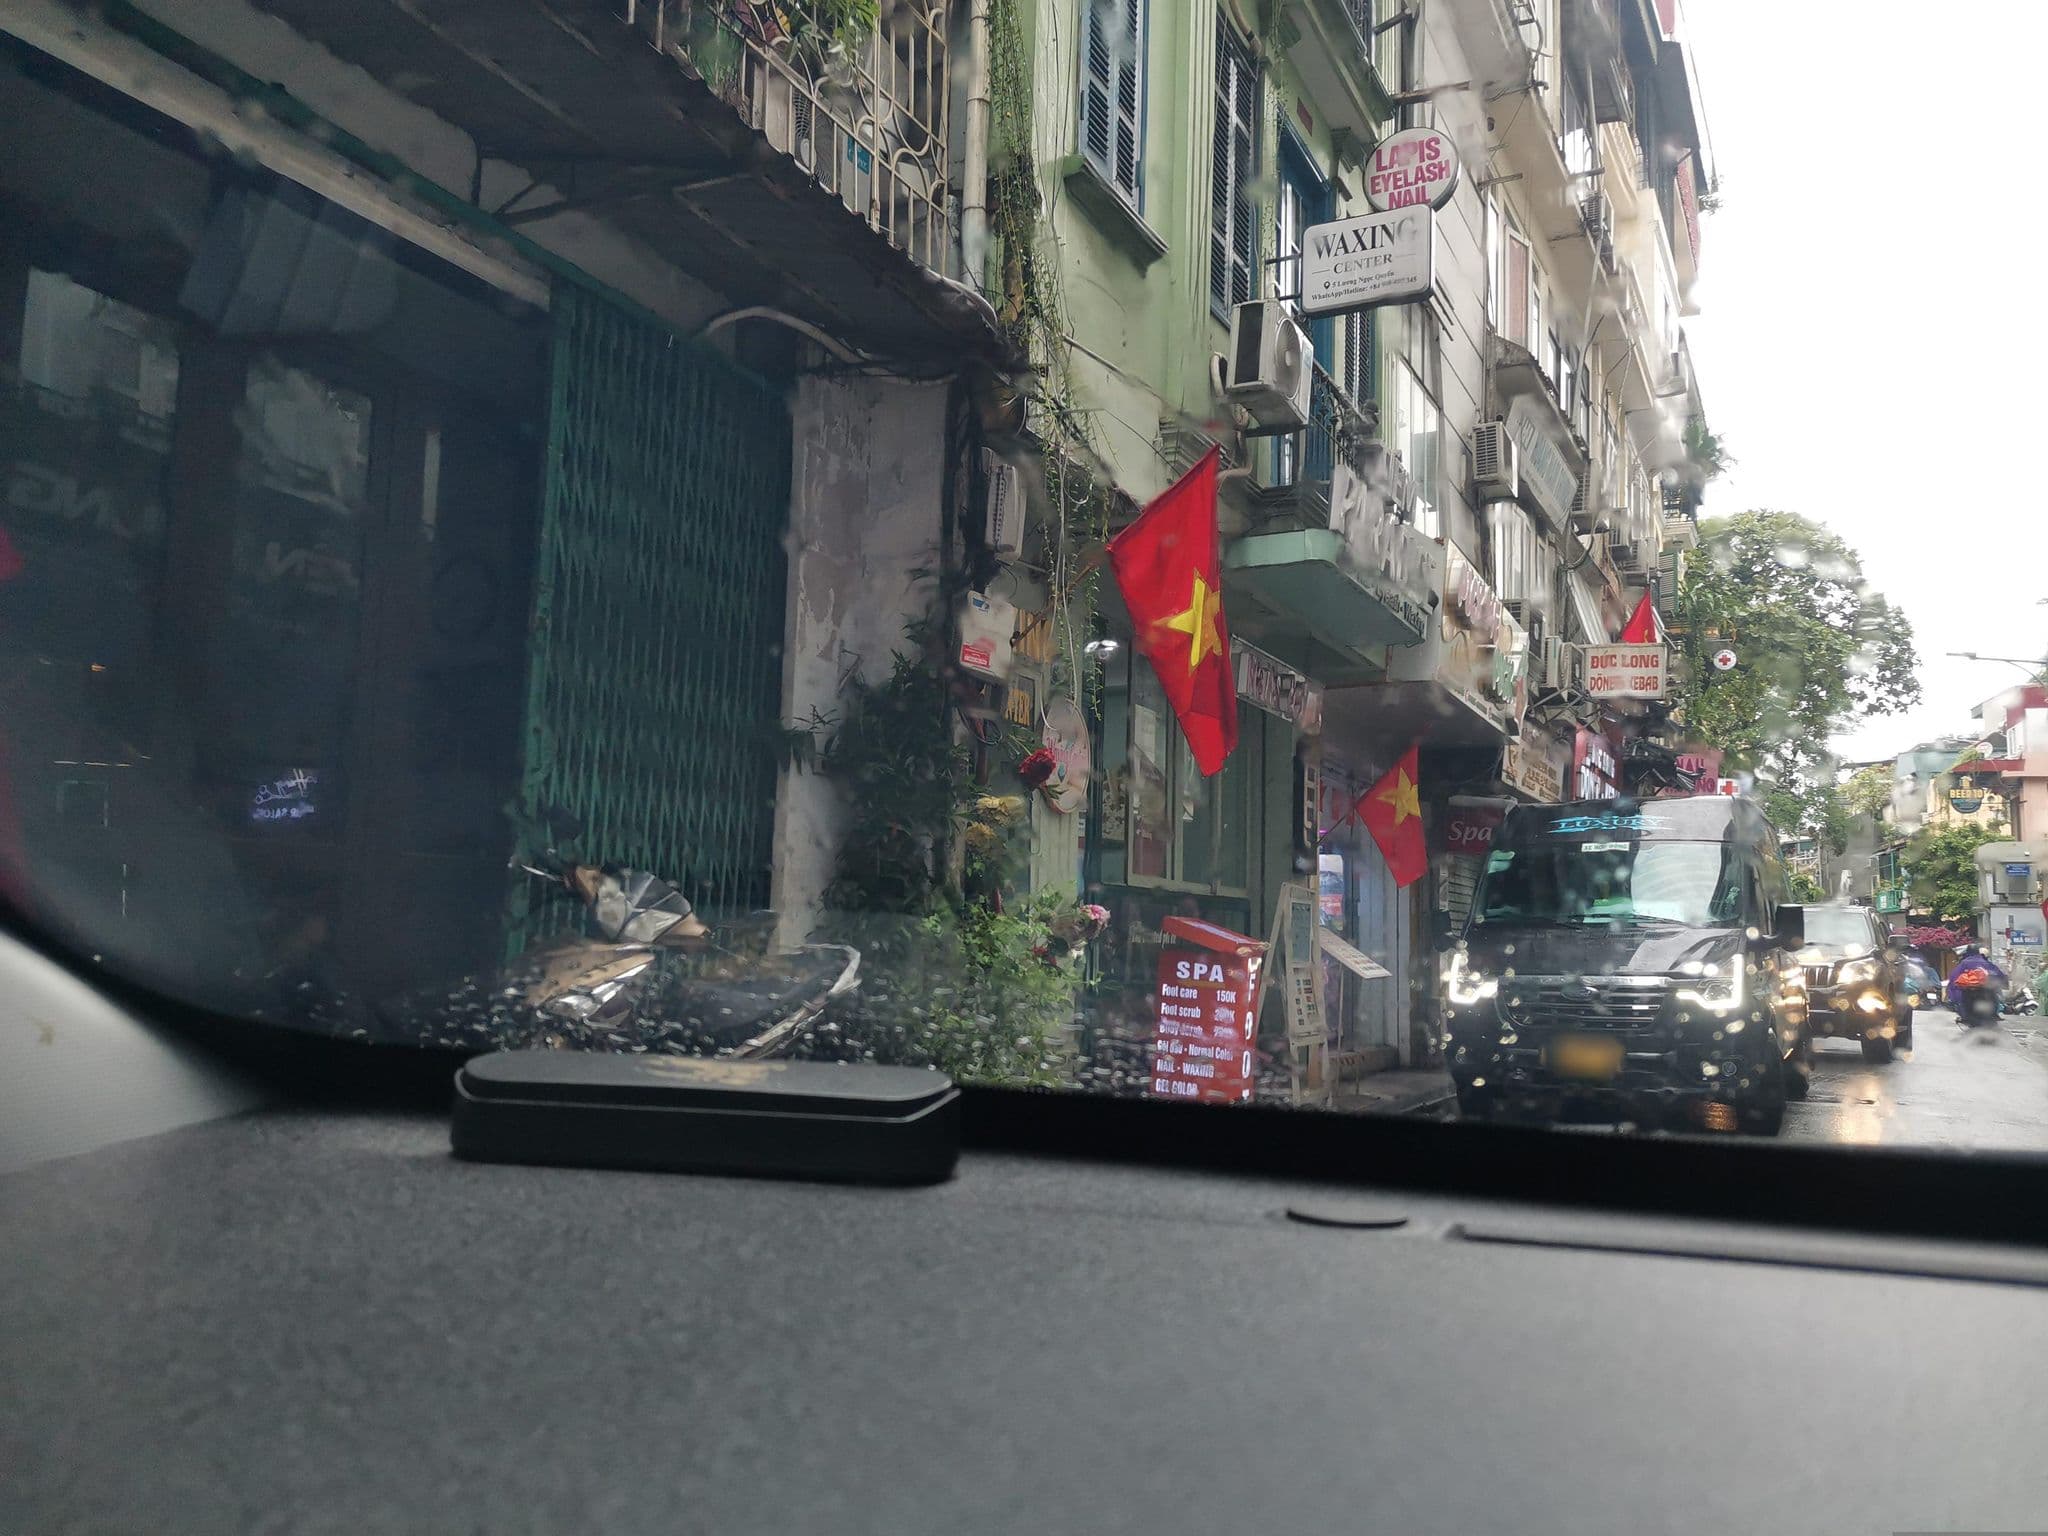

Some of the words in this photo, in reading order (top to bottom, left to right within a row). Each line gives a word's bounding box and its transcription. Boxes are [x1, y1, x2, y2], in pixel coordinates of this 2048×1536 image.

[1370, 158, 1451, 196] EYELASH
[1388, 185, 1431, 209] NAIL
[1312, 216, 1418, 260] WAXING
[1333, 253, 1393, 274] CENTER
[1621, 654, 1659, 668] LONG
[1630, 675, 1659, 691] EBAB
[1448, 820, 1492, 846] Spa
[1176, 961, 1224, 983] SPA
[1162, 983, 1178, 998] Foot
[1180, 987, 1198, 999] care
[1216, 989, 1237, 1003] 150K
[1160, 1002, 1177, 1016] Foot
[1178, 1005, 1201, 1018] scrub
[1188, 1043, 1214, 1059] Normal
[1215, 1046, 1233, 1061] Color
[1156, 1059, 1175, 1073] NAIL
[1182, 1062, 1215, 1079] WAXING
[1155, 1078, 1170, 1093] GEL
[1171, 1080, 1199, 1097] COLOR
